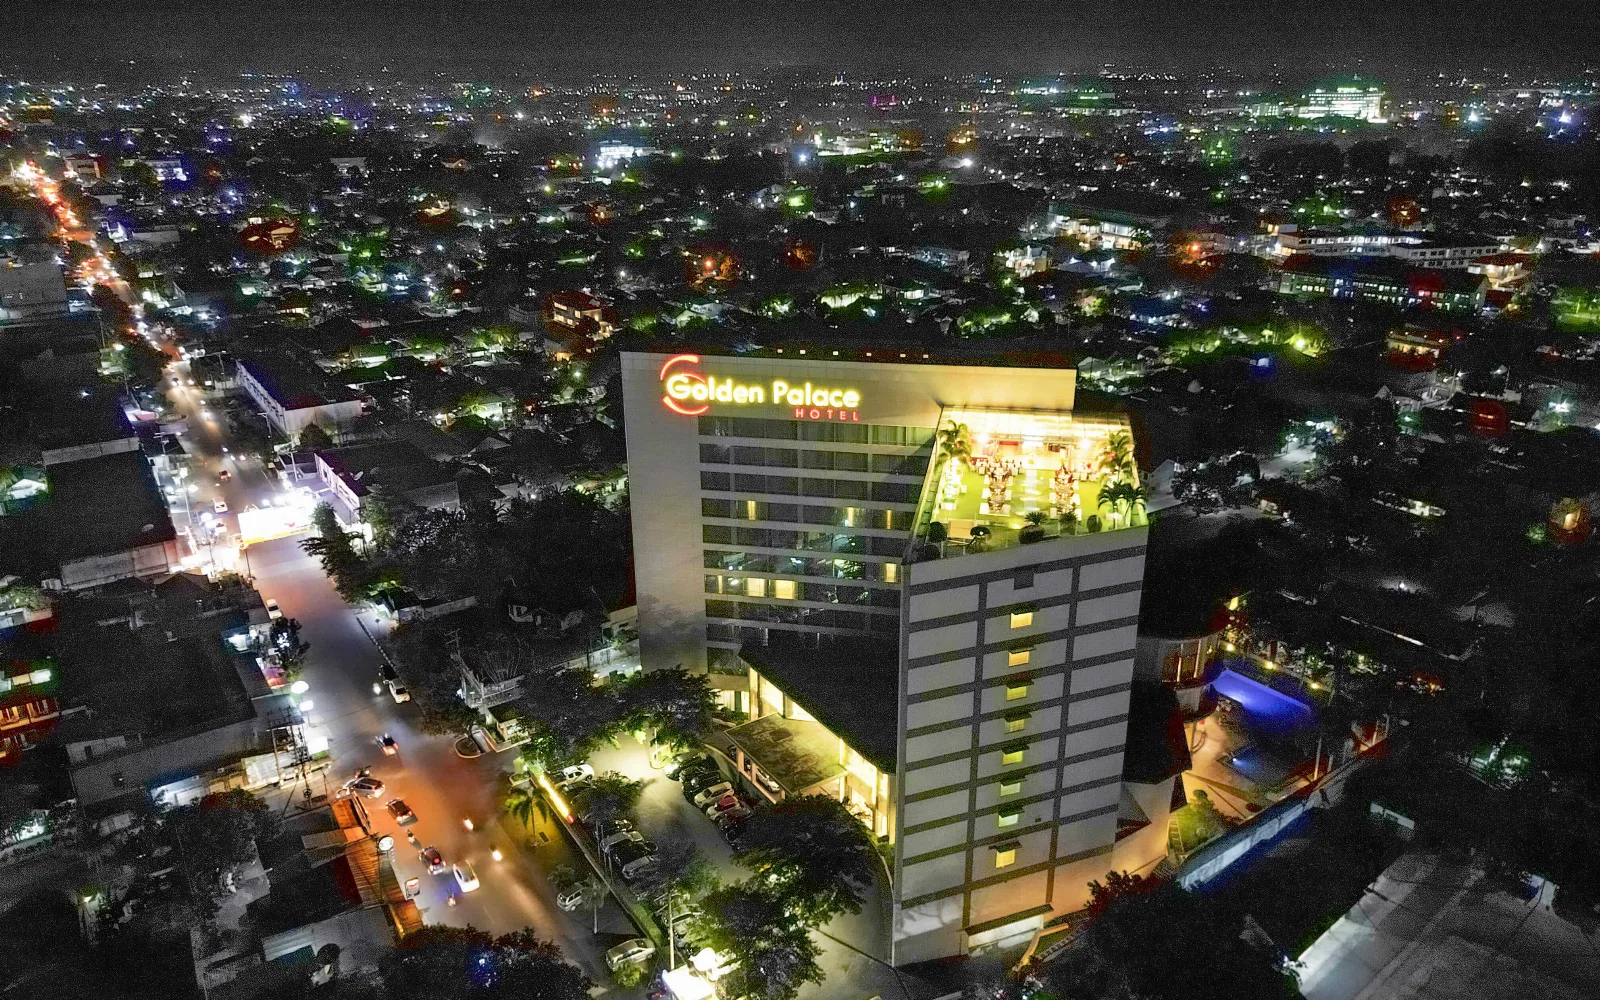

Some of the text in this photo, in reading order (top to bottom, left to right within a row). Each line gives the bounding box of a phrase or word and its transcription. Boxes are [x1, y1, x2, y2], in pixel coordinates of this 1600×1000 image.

[666, 373, 860, 408] Golden Palace
[795, 408, 860, 422] HOTEL
